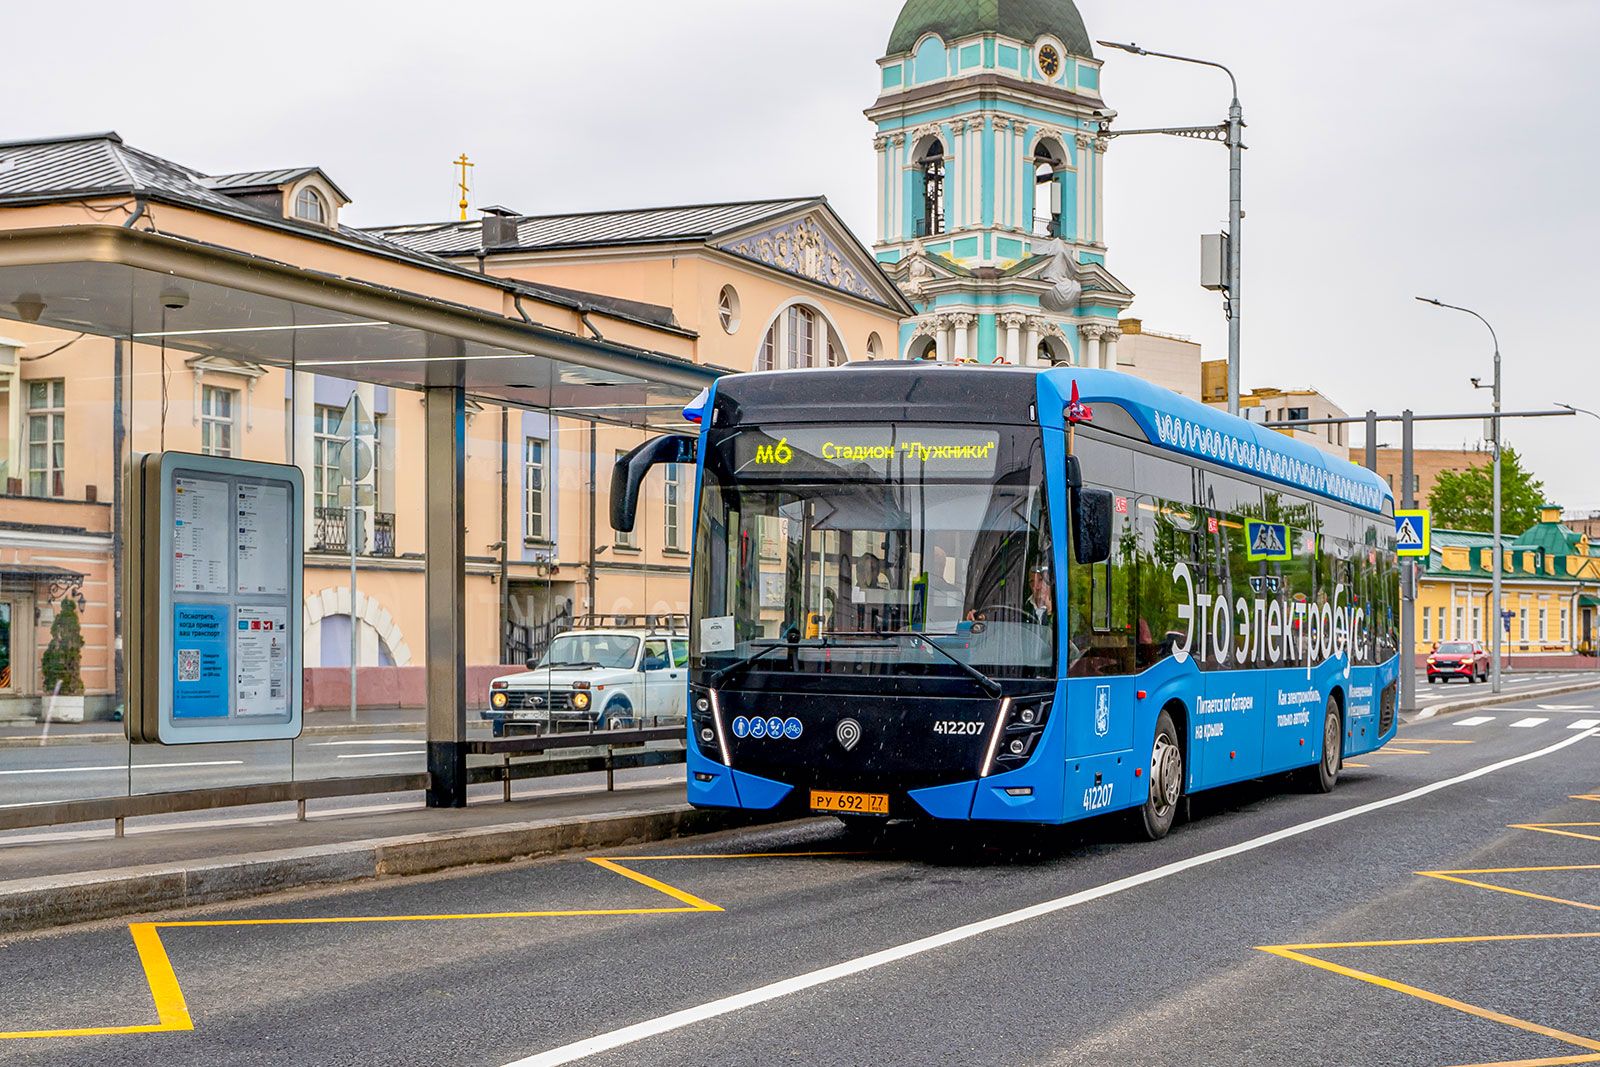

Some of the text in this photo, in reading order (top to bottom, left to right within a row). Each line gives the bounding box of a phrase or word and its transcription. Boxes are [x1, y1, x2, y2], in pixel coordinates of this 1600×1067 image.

[821, 441, 895, 461] Стадион
[901, 441, 995, 462] "Лужники"
[1171, 562, 1230, 664] Это
[1196, 692, 1254, 715] Питается от батареи
[1278, 689, 1287, 705] Как
[933, 721, 985, 735] 412207
[1195, 722, 1224, 742] на крыше
[838, 795, 863, 810] 692
[871, 796, 884, 806] 77
[1082, 783, 1114, 811] 412207
